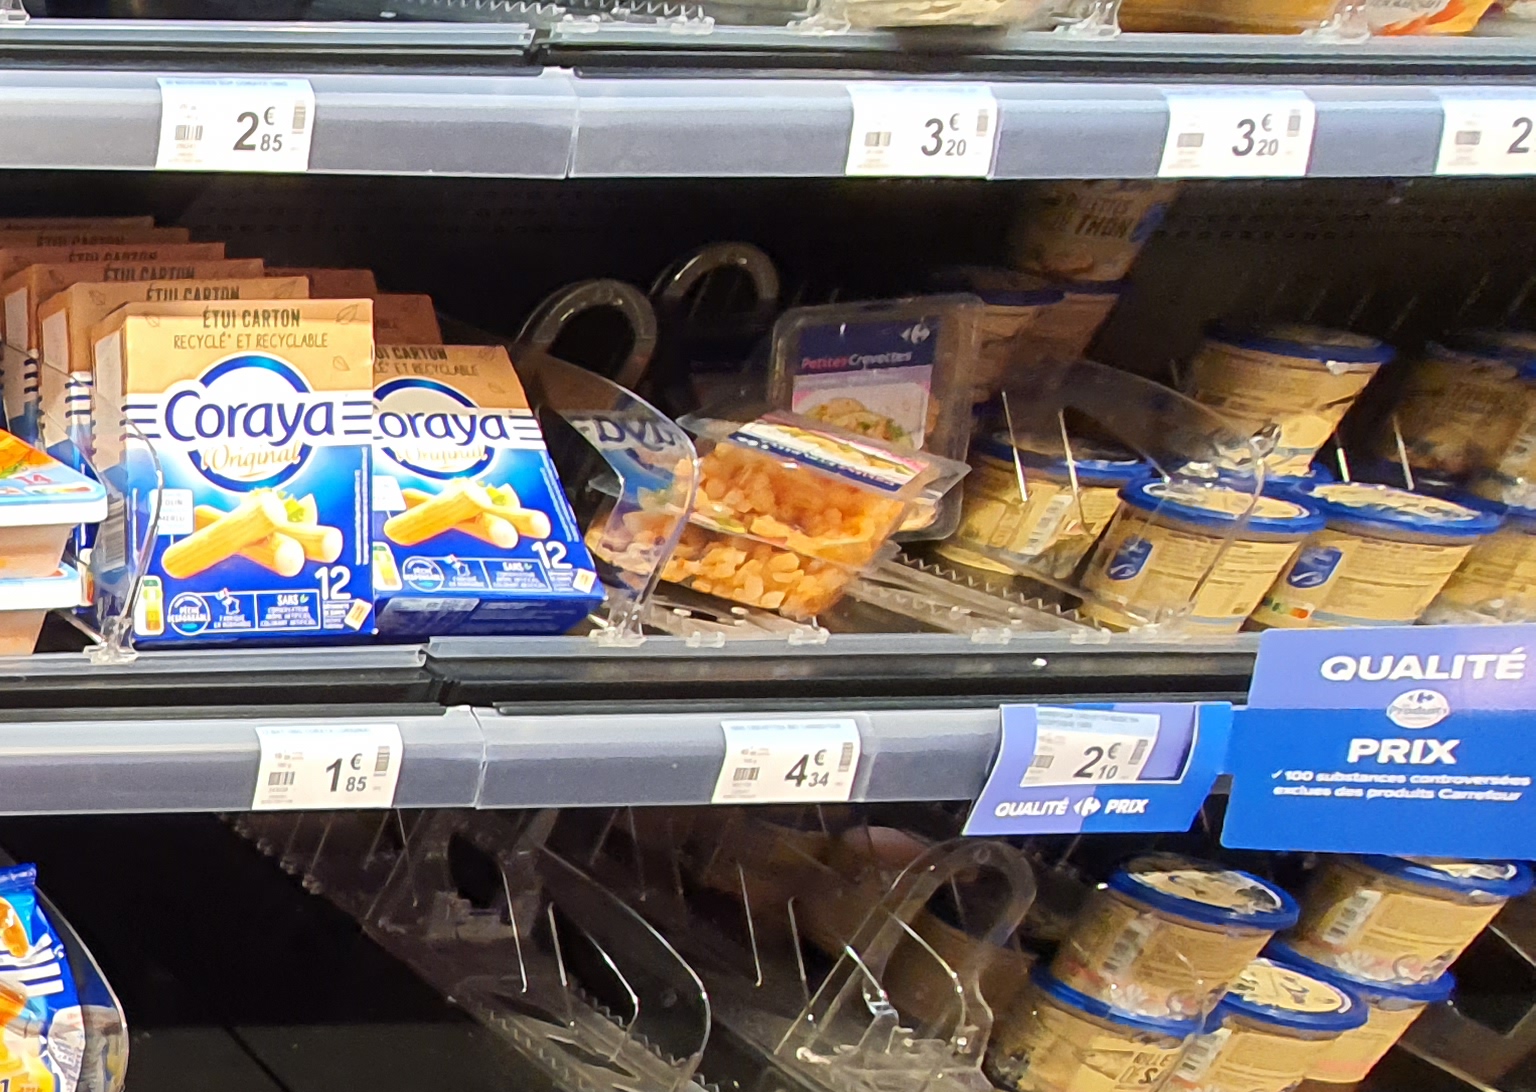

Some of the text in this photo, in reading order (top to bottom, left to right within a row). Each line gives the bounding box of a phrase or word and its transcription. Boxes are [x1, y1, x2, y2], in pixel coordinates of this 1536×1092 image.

[202, 307, 301, 329] ÉTUI CARTON
[236, 336, 253, 355] ET
[256, 333, 329, 355] RECYCLABLE
[164, 389, 335, 447] Coraya
[378, 411, 510, 447] oraya
[531, 541, 573, 570] 12
[314, 565, 352, 600] 12
[1320, 645, 1528, 682] QUALITÉ
[1346, 737, 1461, 765] PRIX
[994, 796, 1150, 818] QUALITÉ PRIX
